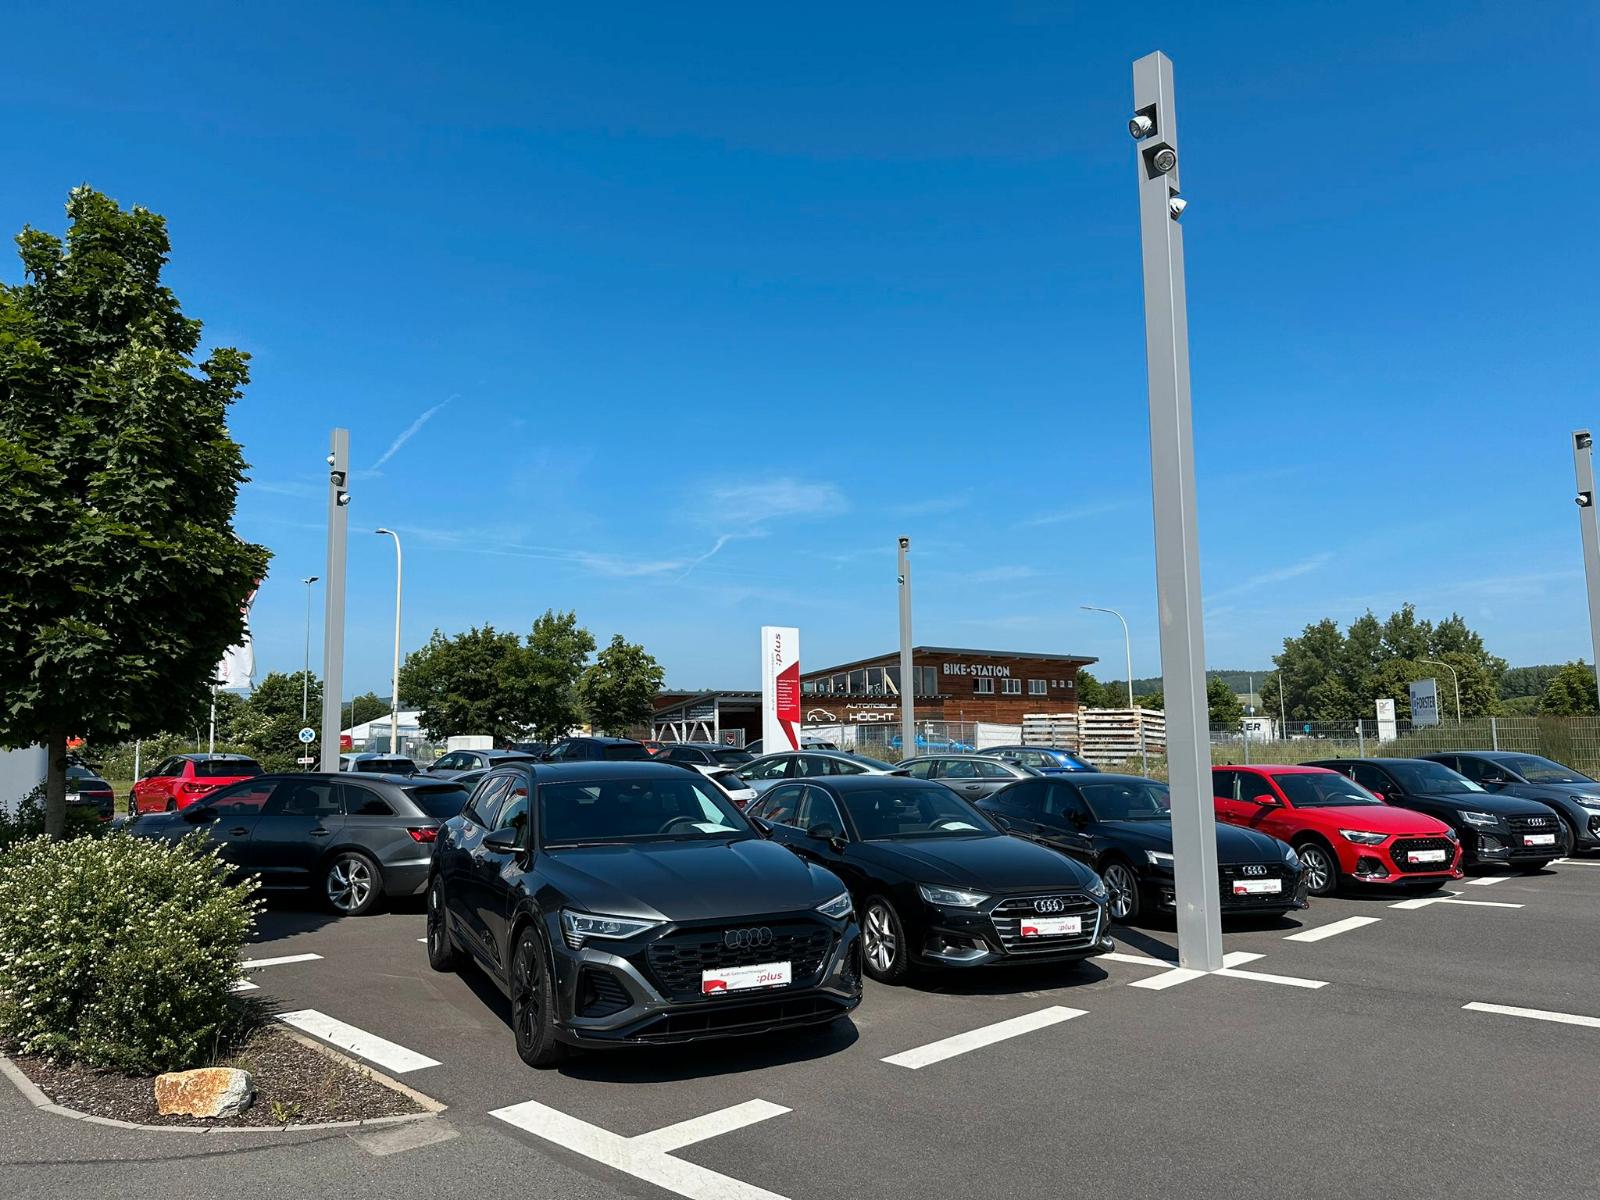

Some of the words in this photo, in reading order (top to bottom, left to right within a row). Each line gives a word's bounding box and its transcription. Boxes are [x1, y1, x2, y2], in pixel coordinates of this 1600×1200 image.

[774, 633, 783, 666] :plus
[943, 663, 1010, 677] BIKE-STATION
[849, 710, 895, 721] HÖCHT
[756, 972, 783, 983] :plus
